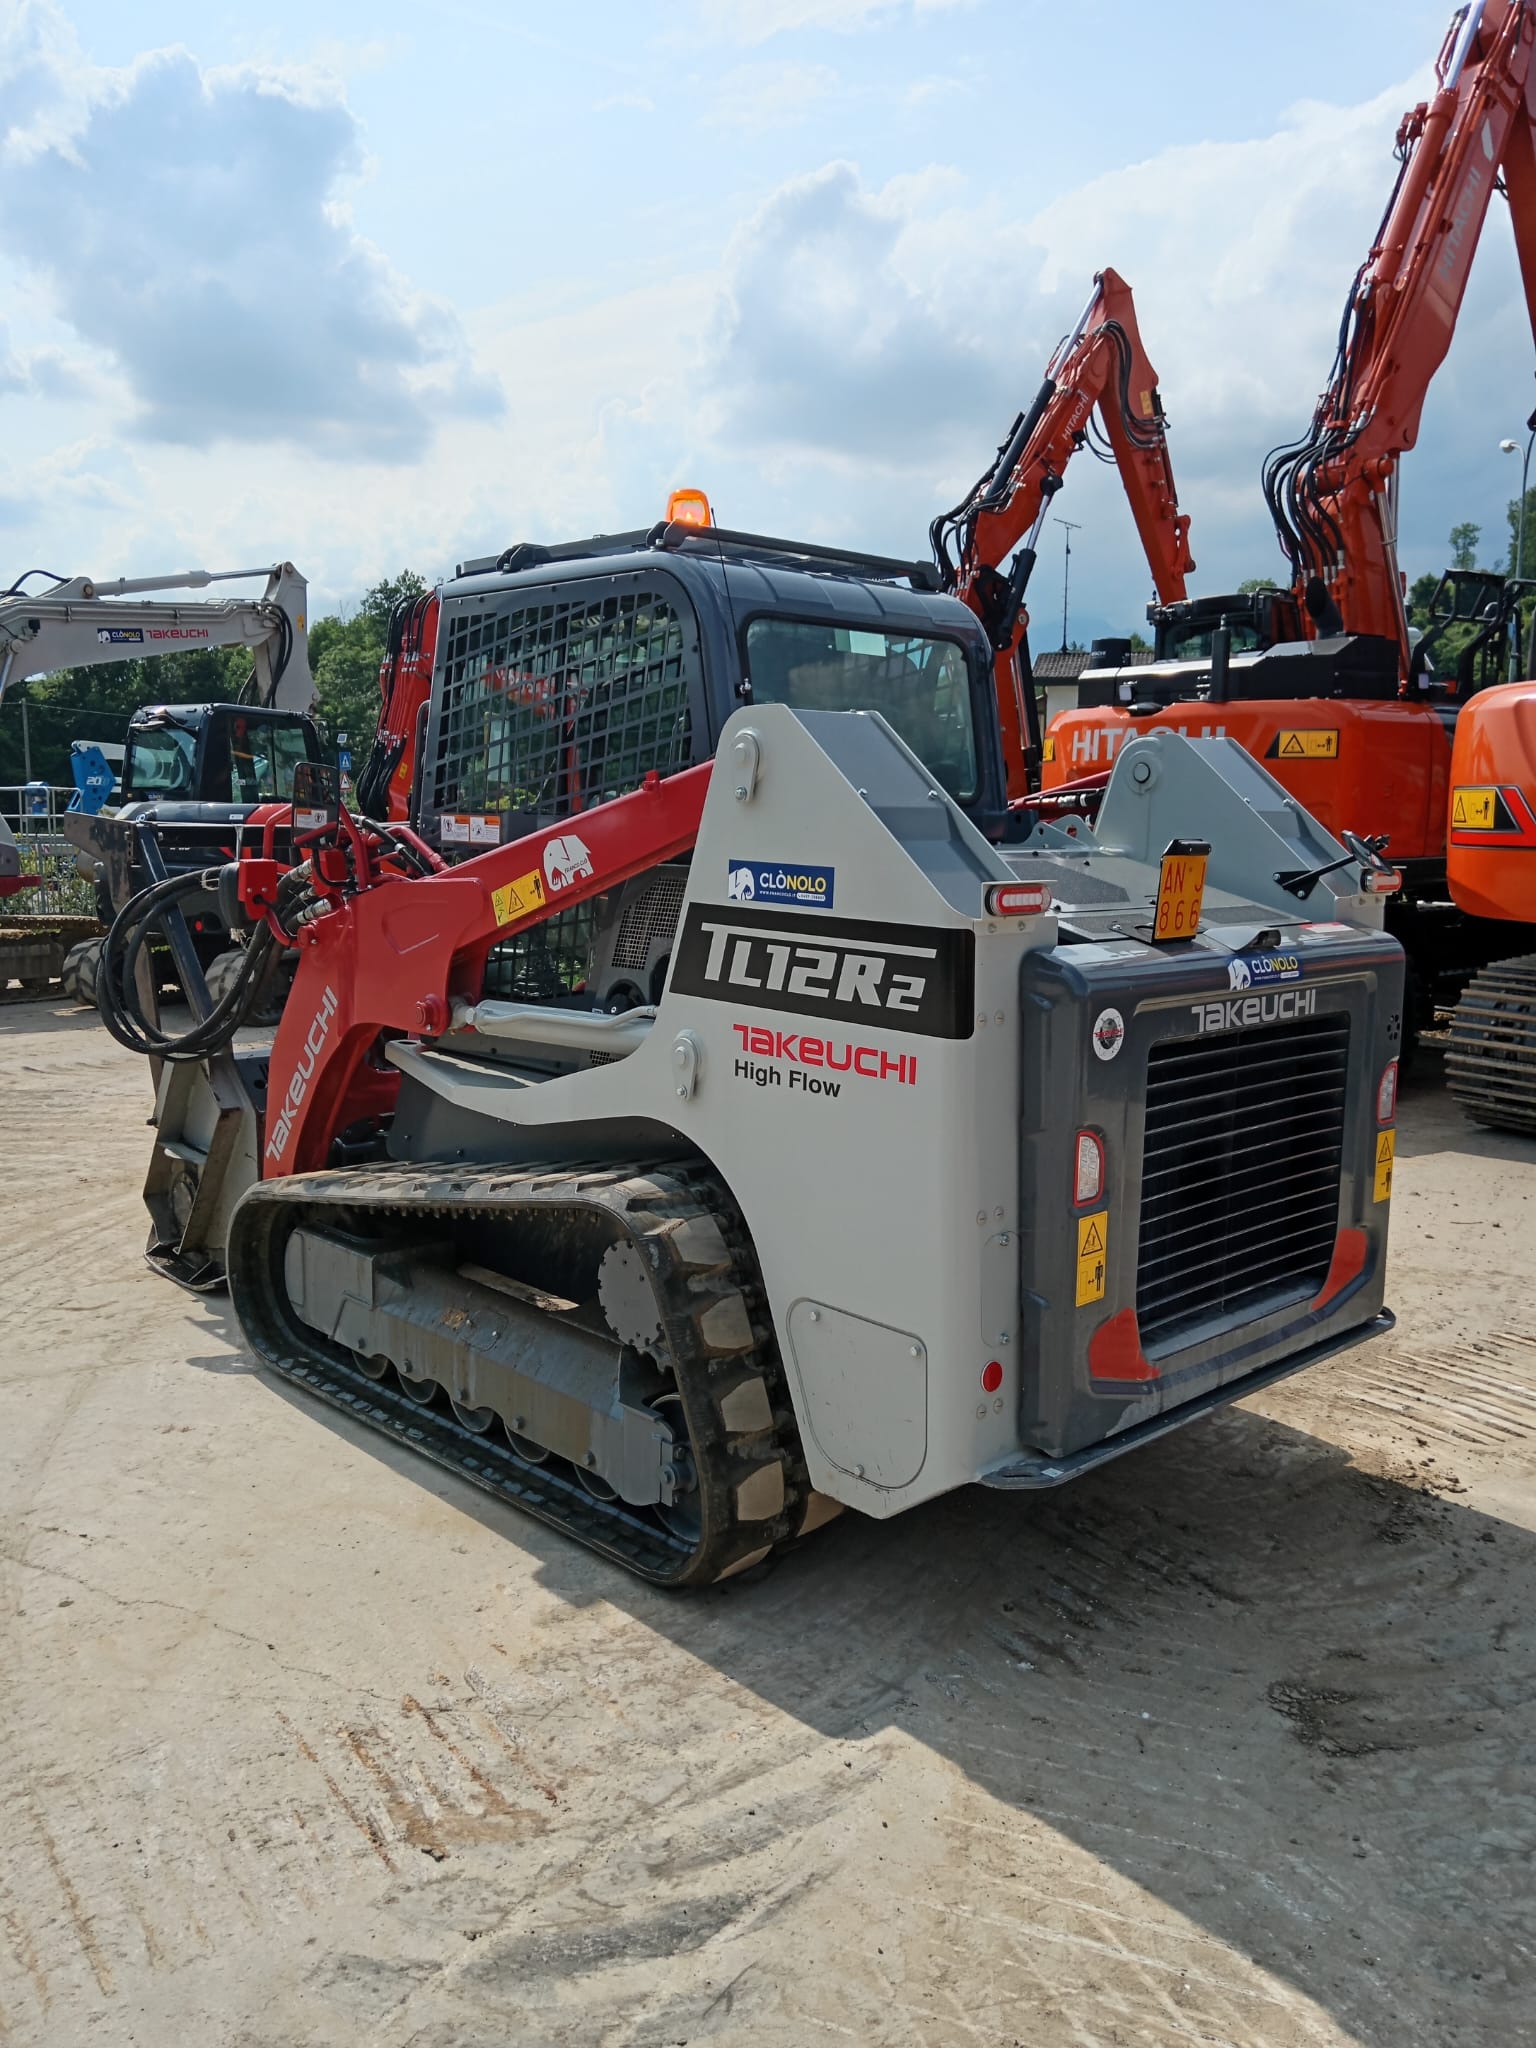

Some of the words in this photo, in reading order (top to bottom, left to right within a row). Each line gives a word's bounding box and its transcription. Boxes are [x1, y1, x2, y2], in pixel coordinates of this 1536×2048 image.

[1062, 389, 1089, 440] HITACHI
[759, 869, 827, 893] CLÒNOLO
[1163, 862, 1187, 894] AN
[1195, 861, 1206, 892] J
[1159, 899, 1200, 931] 866
[701, 922, 937, 1012] TL12R2
[1191, 989, 1316, 1032] TAKEUCHI
[266, 985, 338, 1161] TAKEUCHI
[733, 1023, 917, 1085] TAKEUCHI
[734, 1059, 781, 1086] High
[789, 1070, 841, 1097] Flow
